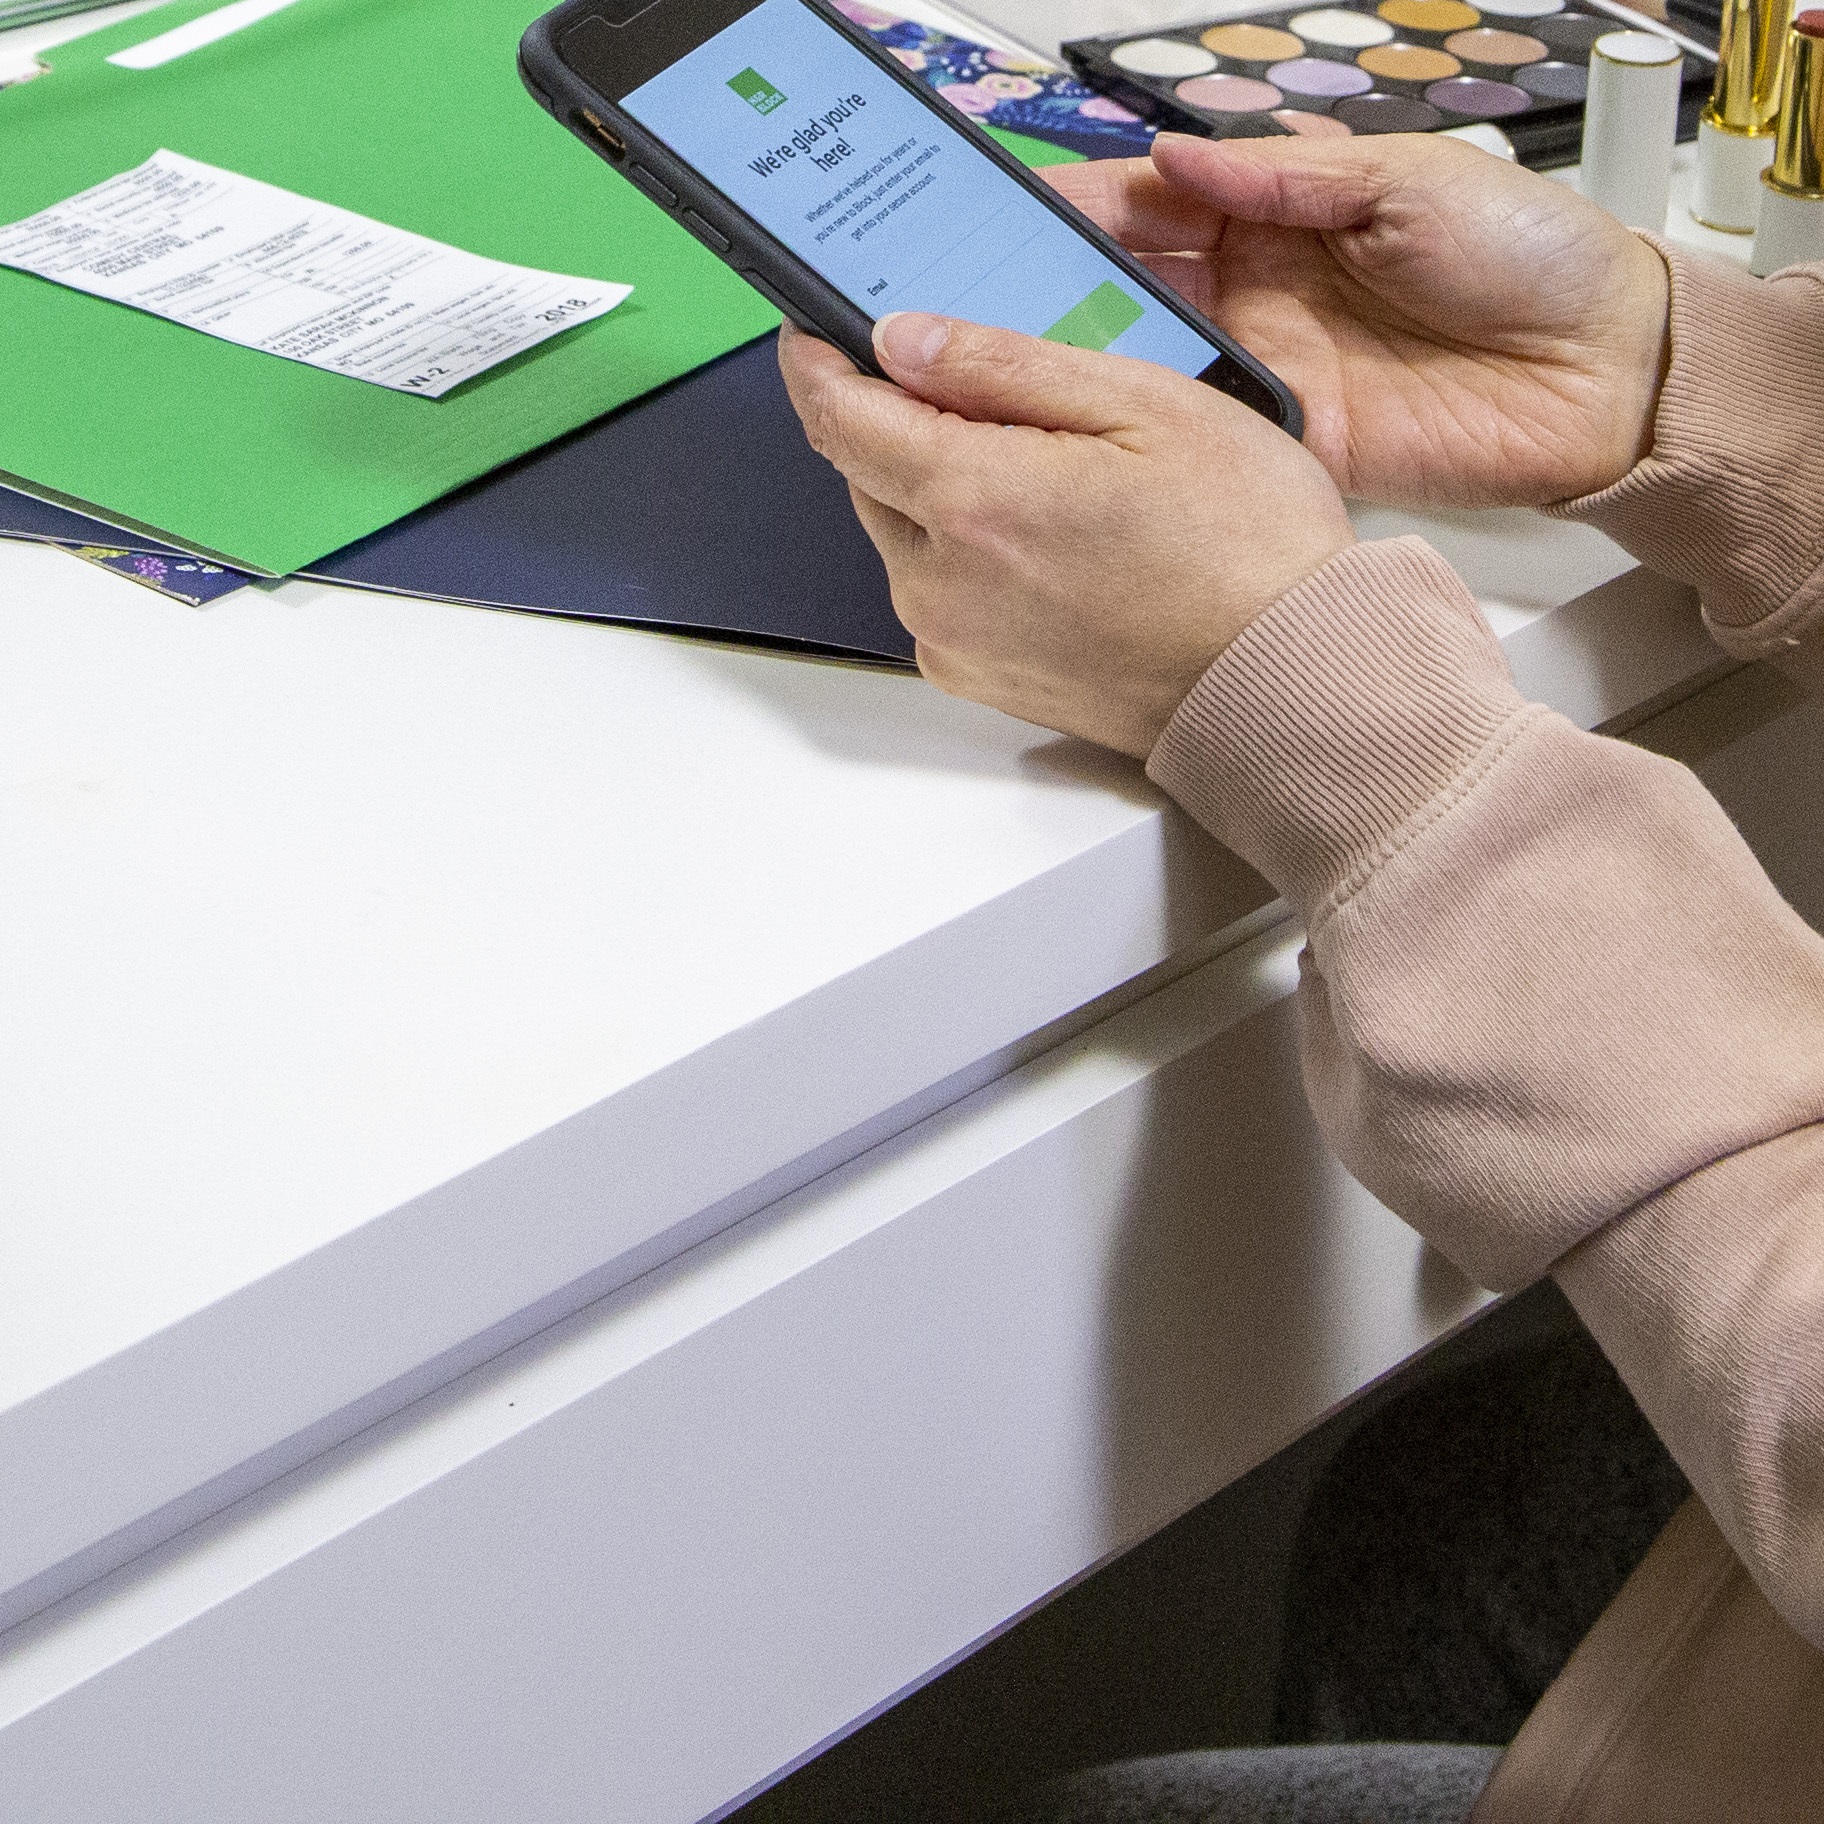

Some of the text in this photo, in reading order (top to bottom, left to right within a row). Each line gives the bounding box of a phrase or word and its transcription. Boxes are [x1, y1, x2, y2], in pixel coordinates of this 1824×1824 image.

[756, 92, 785, 113] BLOCK
[747, 93, 867, 178] We're glad you're
[810, 137, 856, 173] here!
[805, 137, 918, 223] Whether we've helped you for years or
[814, 225, 836, 244] you're
[833, 214, 849, 227] new
[846, 207, 857, 218] to
[871, 184, 888, 201] just
[885, 172, 903, 189] enter
[900, 163, 916, 178] your
[914, 148, 934, 167] email
[931, 144, 941, 154] to
[851, 227, 864, 242] get
[861, 218, 877, 232] into
[874, 207, 891, 224] your
[888, 192, 911, 211] secure
[867, 277, 889, 297] Email
[272, 337, 300, 350] KATE
[299, 321, 336, 337] SARAH
[296, 338, 339, 358] KANSAS
[339, 326, 363, 338] CITY
[365, 317, 385, 326] MO
[301, 334, 326, 346] OAK
[325, 317, 364, 334] STREET
[400, 298, 587, 389] W-2 2018
